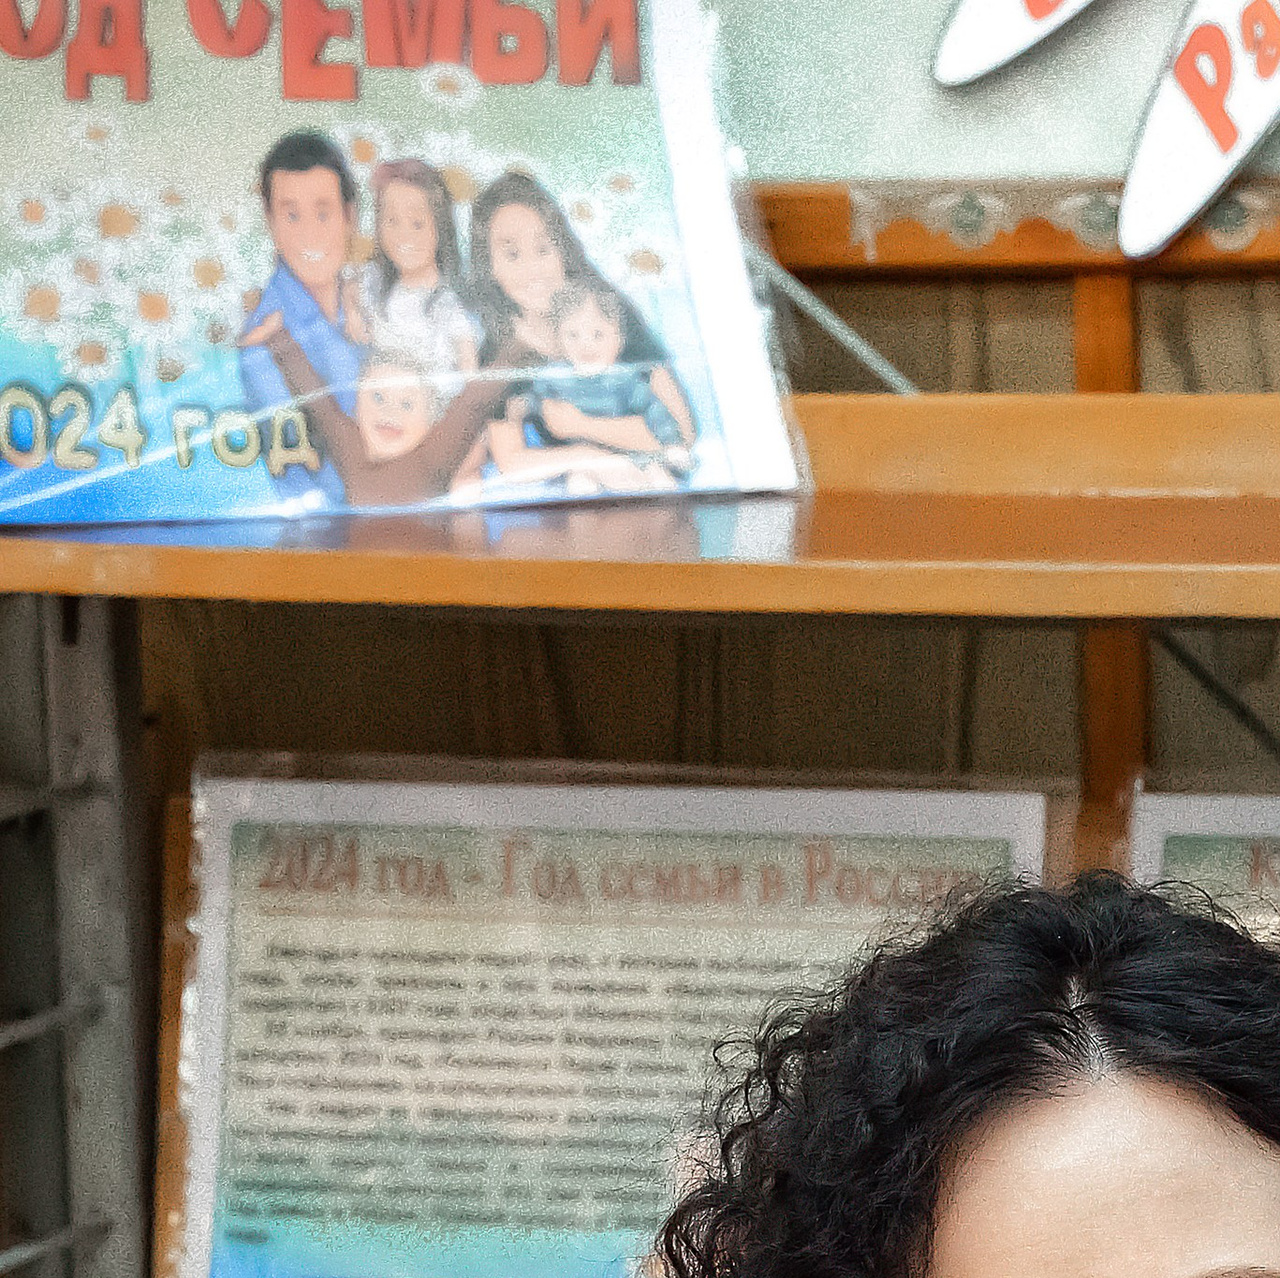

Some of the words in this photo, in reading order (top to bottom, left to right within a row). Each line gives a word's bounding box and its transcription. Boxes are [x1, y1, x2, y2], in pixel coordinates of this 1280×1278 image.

[185, 0, 643, 101] СЕМЬИ
[172, 405, 321, 477] год
[257, 828, 362, 892] 2024
